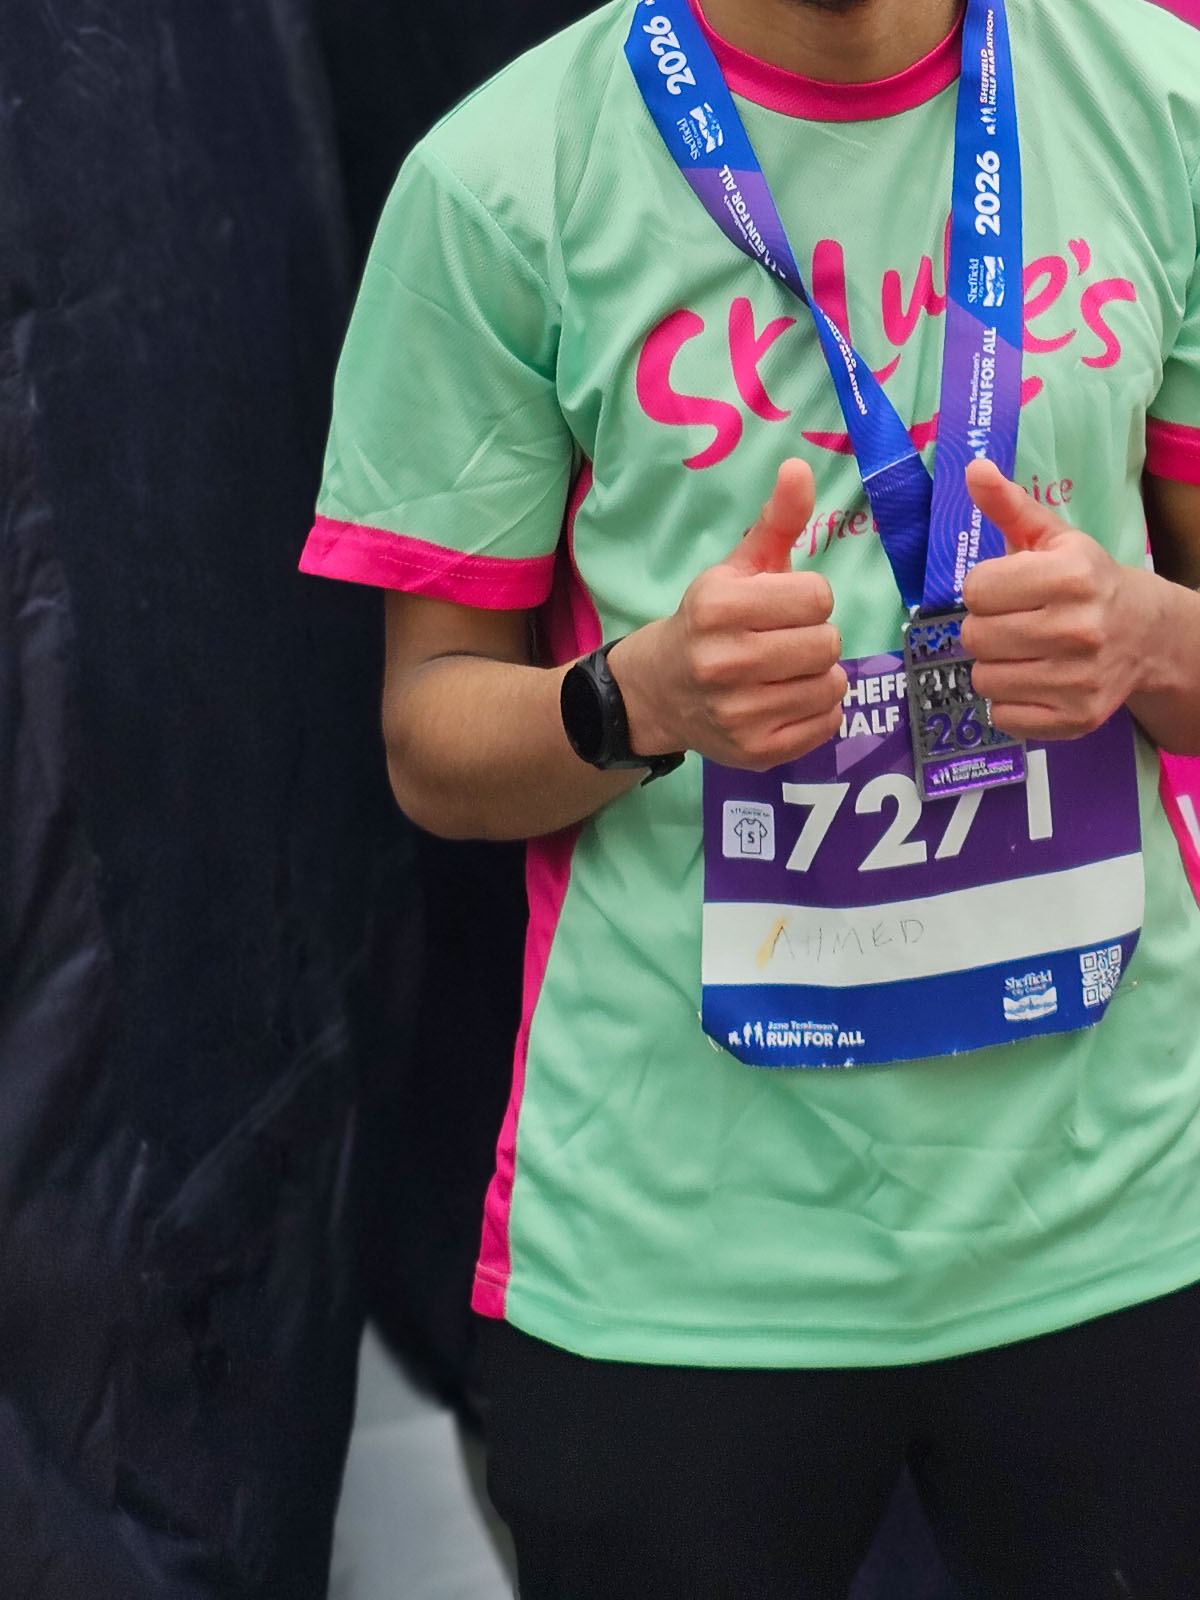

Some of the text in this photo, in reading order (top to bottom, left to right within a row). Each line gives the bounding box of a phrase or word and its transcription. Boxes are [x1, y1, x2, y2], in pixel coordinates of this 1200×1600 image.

[643, 15, 696, 95] 2026
[718, 164, 767, 256] RUN FOR ALL
[974, 150, 1000, 237] 2026
[967, 258, 980, 304] Sheffield
[636, 208, 1138, 470] St Lue's
[977, 326, 997, 428] RUN FOR ALL
[953, 530, 969, 592] SHEFFIELD
[769, 919, 925, 963] AHMED
[766, 1030, 865, 1048] RUN FOR ALL
